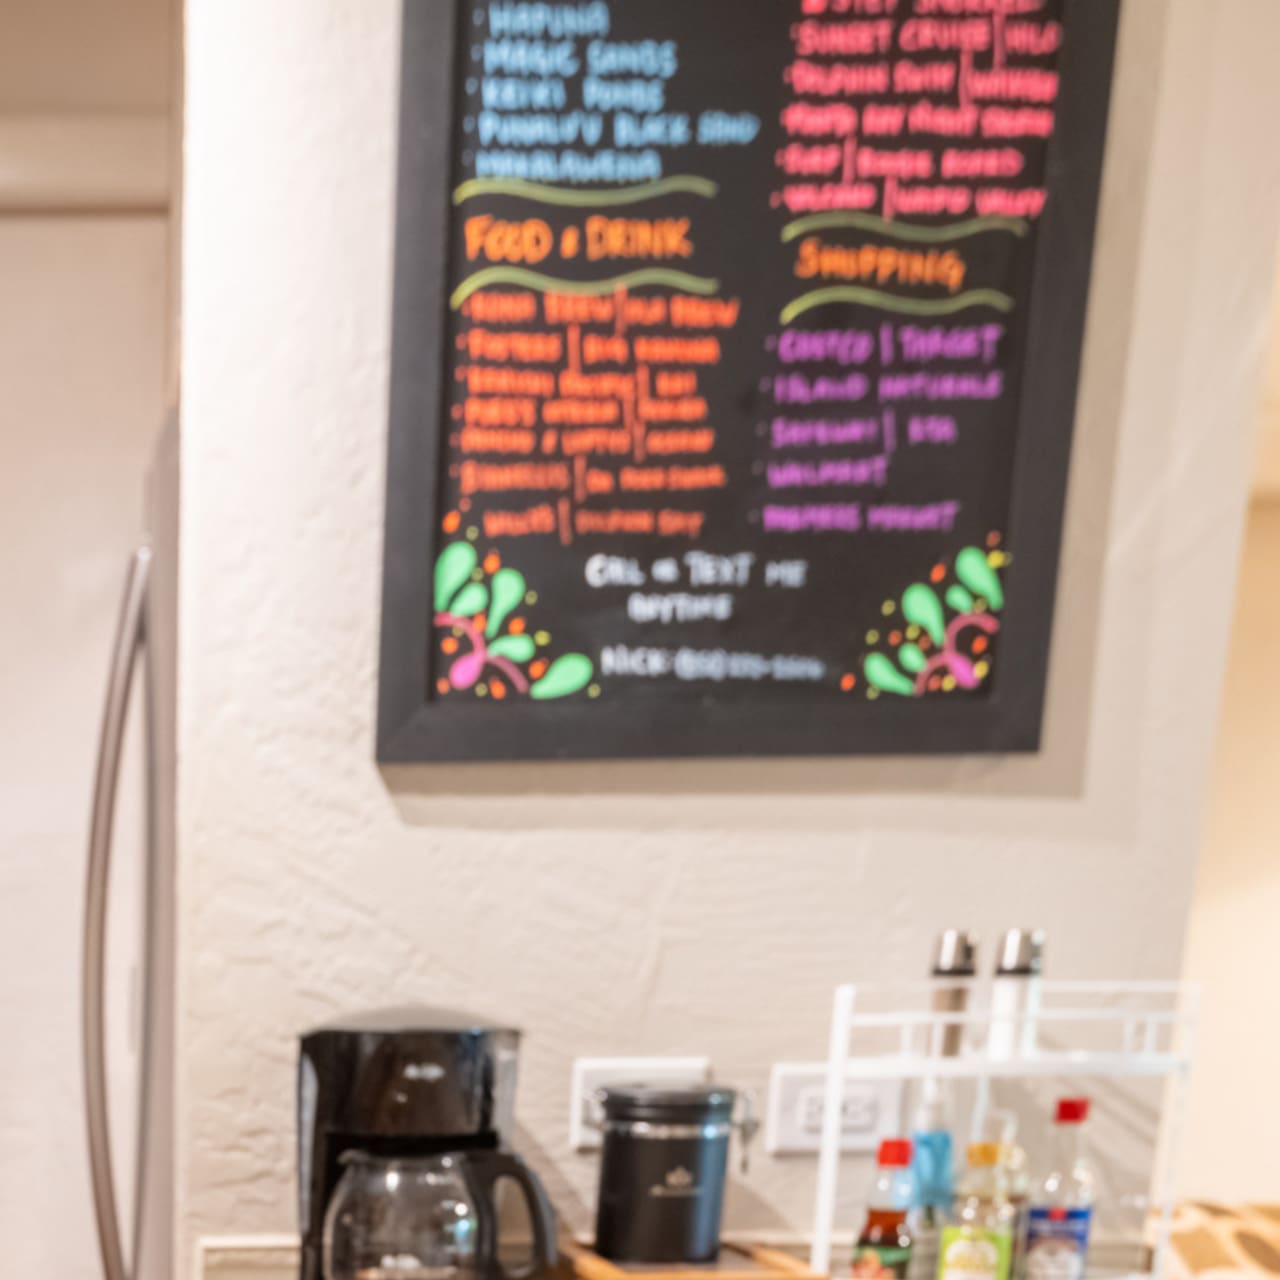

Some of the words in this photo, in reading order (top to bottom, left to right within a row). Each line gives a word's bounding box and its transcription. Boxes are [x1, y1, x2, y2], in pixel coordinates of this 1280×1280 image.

[464, 214, 554, 264] FOOD
[585, 214, 694, 261] DRINK
[794, 237, 967, 292] SHOPPING
[684, 550, 756, 587] TEXT
